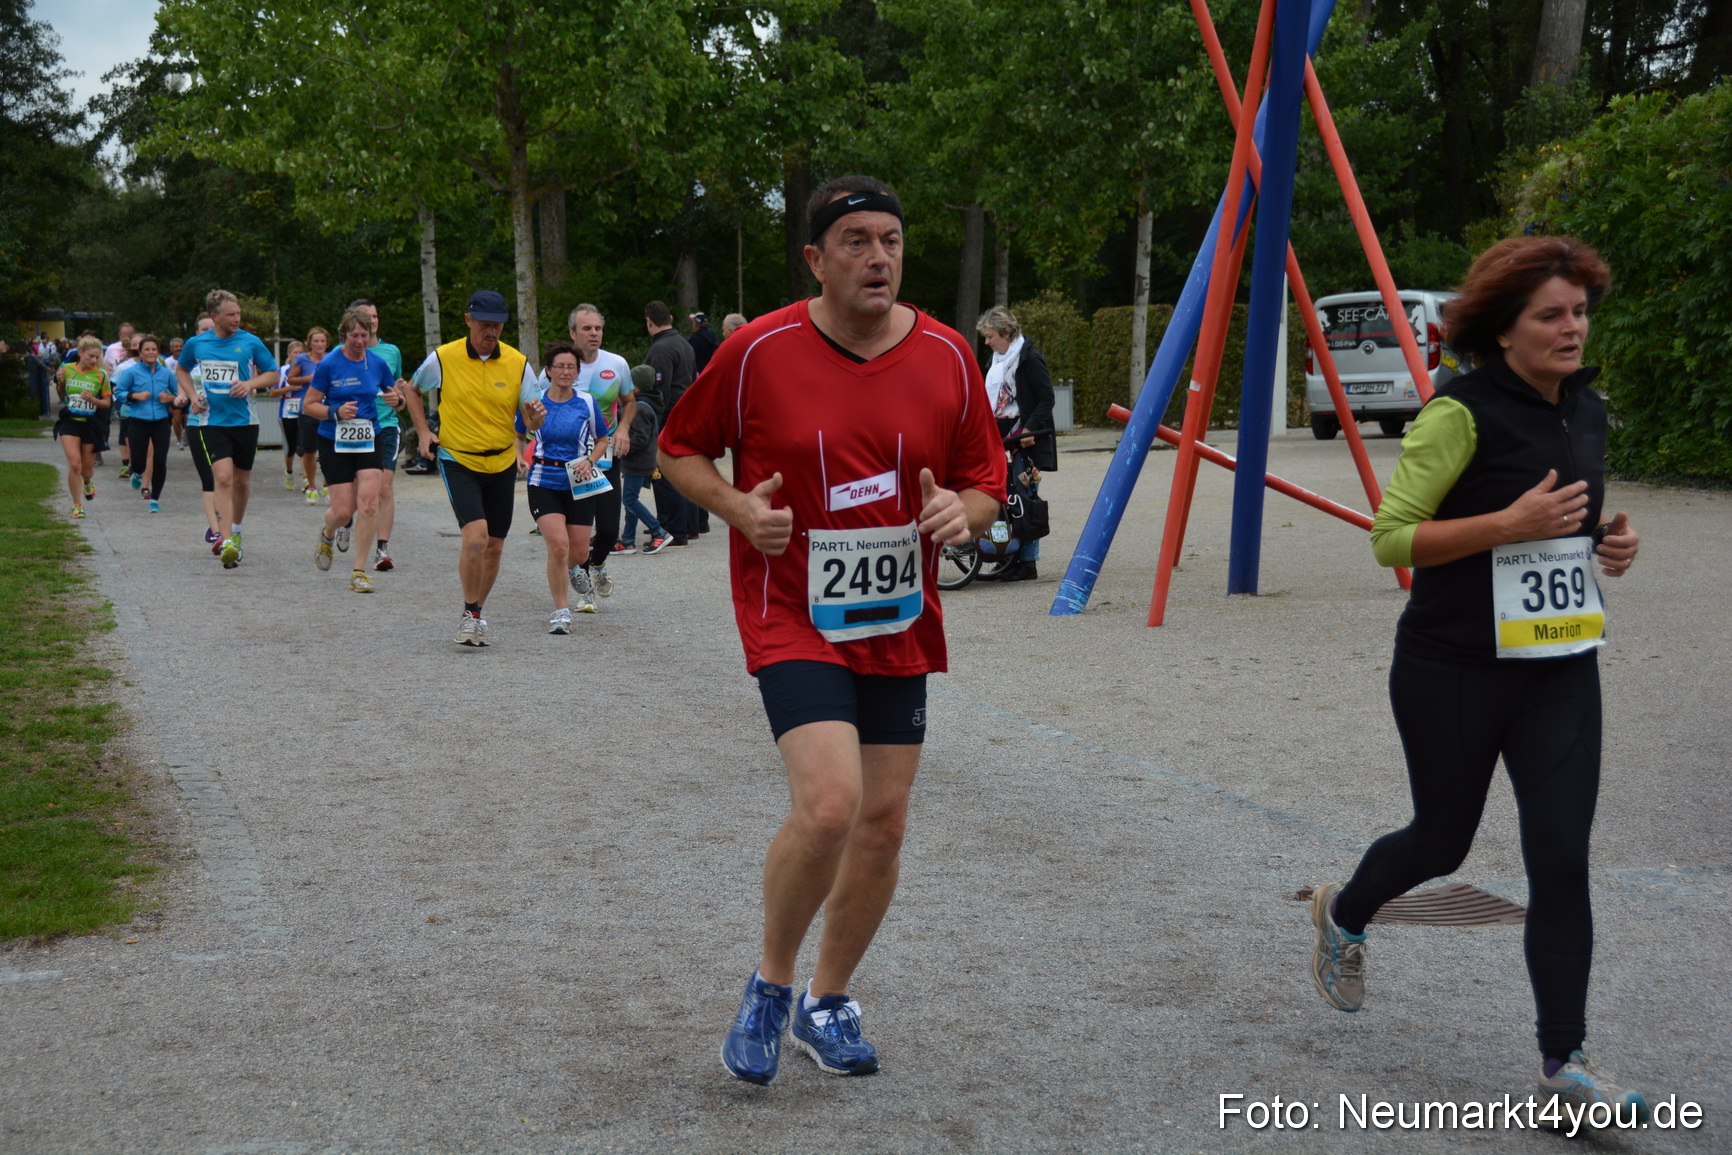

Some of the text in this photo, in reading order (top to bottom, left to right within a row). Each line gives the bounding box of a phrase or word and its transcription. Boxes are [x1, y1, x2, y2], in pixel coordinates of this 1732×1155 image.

[205, 368, 236, 381] 2577
[71, 399, 96, 411] 2710
[340, 427, 372, 440] 2288
[849, 483, 880, 500] DEHN
[811, 537, 911, 552] PARTL Neumarkt
[1496, 550, 1585, 567] PARTL Neumarkt
[823, 549, 917, 598] 2494
[1520, 566, 1585, 613] 369
[814, 596, 820, 604] B
[1500, 612, 1507, 620] D
[1534, 622, 1582, 641] Marion
